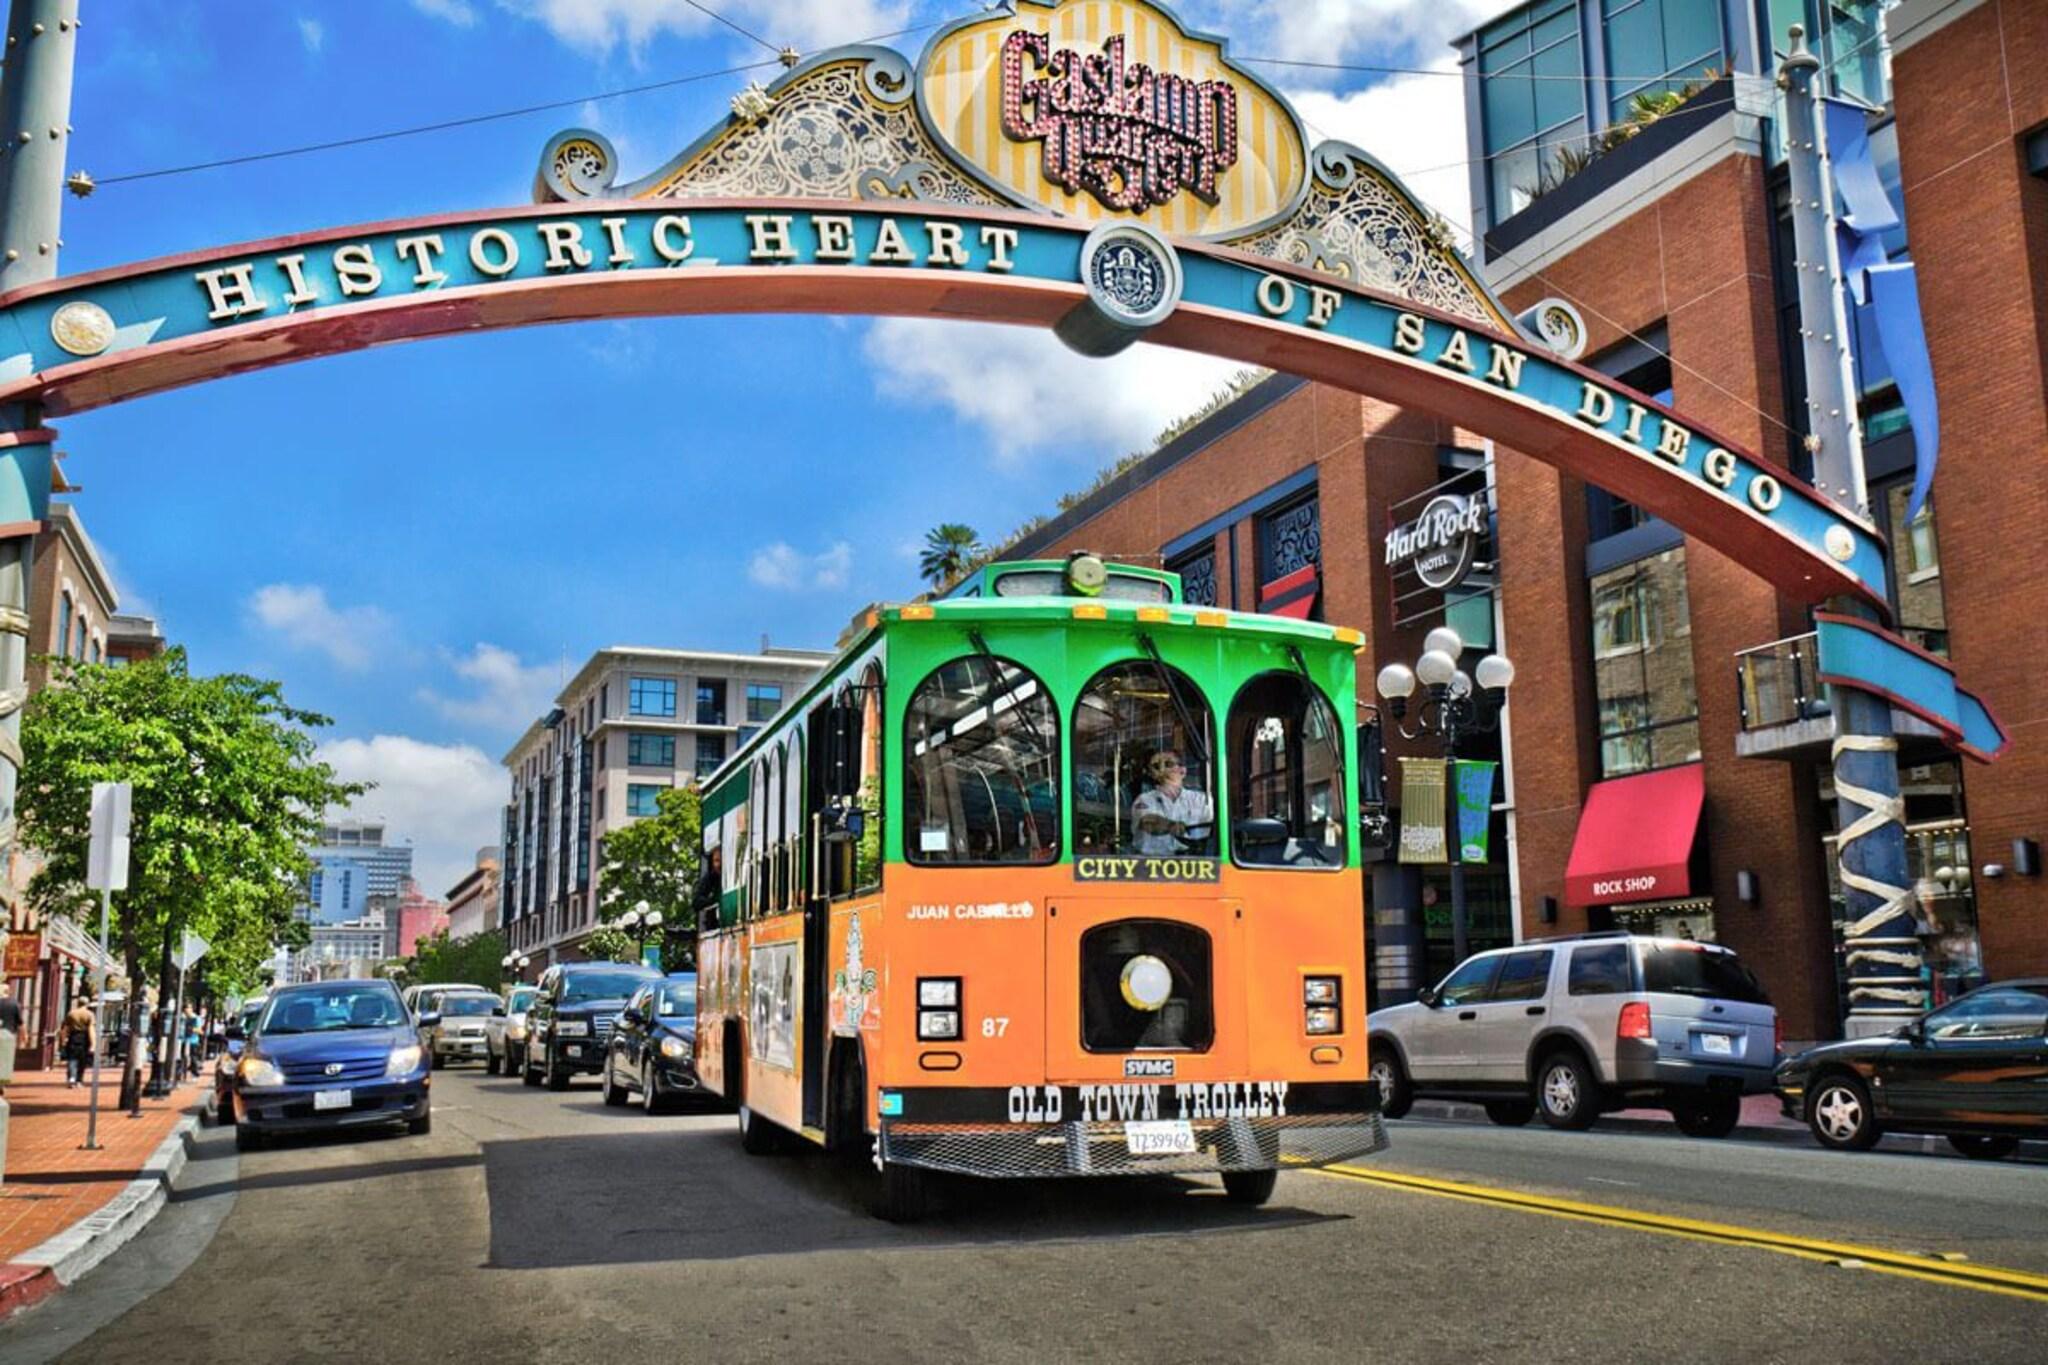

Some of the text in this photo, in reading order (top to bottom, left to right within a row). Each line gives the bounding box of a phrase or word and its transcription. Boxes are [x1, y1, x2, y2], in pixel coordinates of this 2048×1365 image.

[1001, 30, 1237, 172] Gaslamp
[1043, 114, 1221, 213] Quarter
[195, 214, 1783, 512] HISTORIC HEART OF SAN DIEGO
[1384, 494, 1482, 565] Hard Rock
[1420, 553, 1448, 573] HOTEL
[1078, 858, 1216, 880] CITY TOUR
[1593, 876, 1657, 896] ROCK SHOP
[907, 904, 950, 920] JUAN
[982, 1017, 1010, 1038] 87
[1008, 1081, 1288, 1123] OLD TOWN TROLLEY
